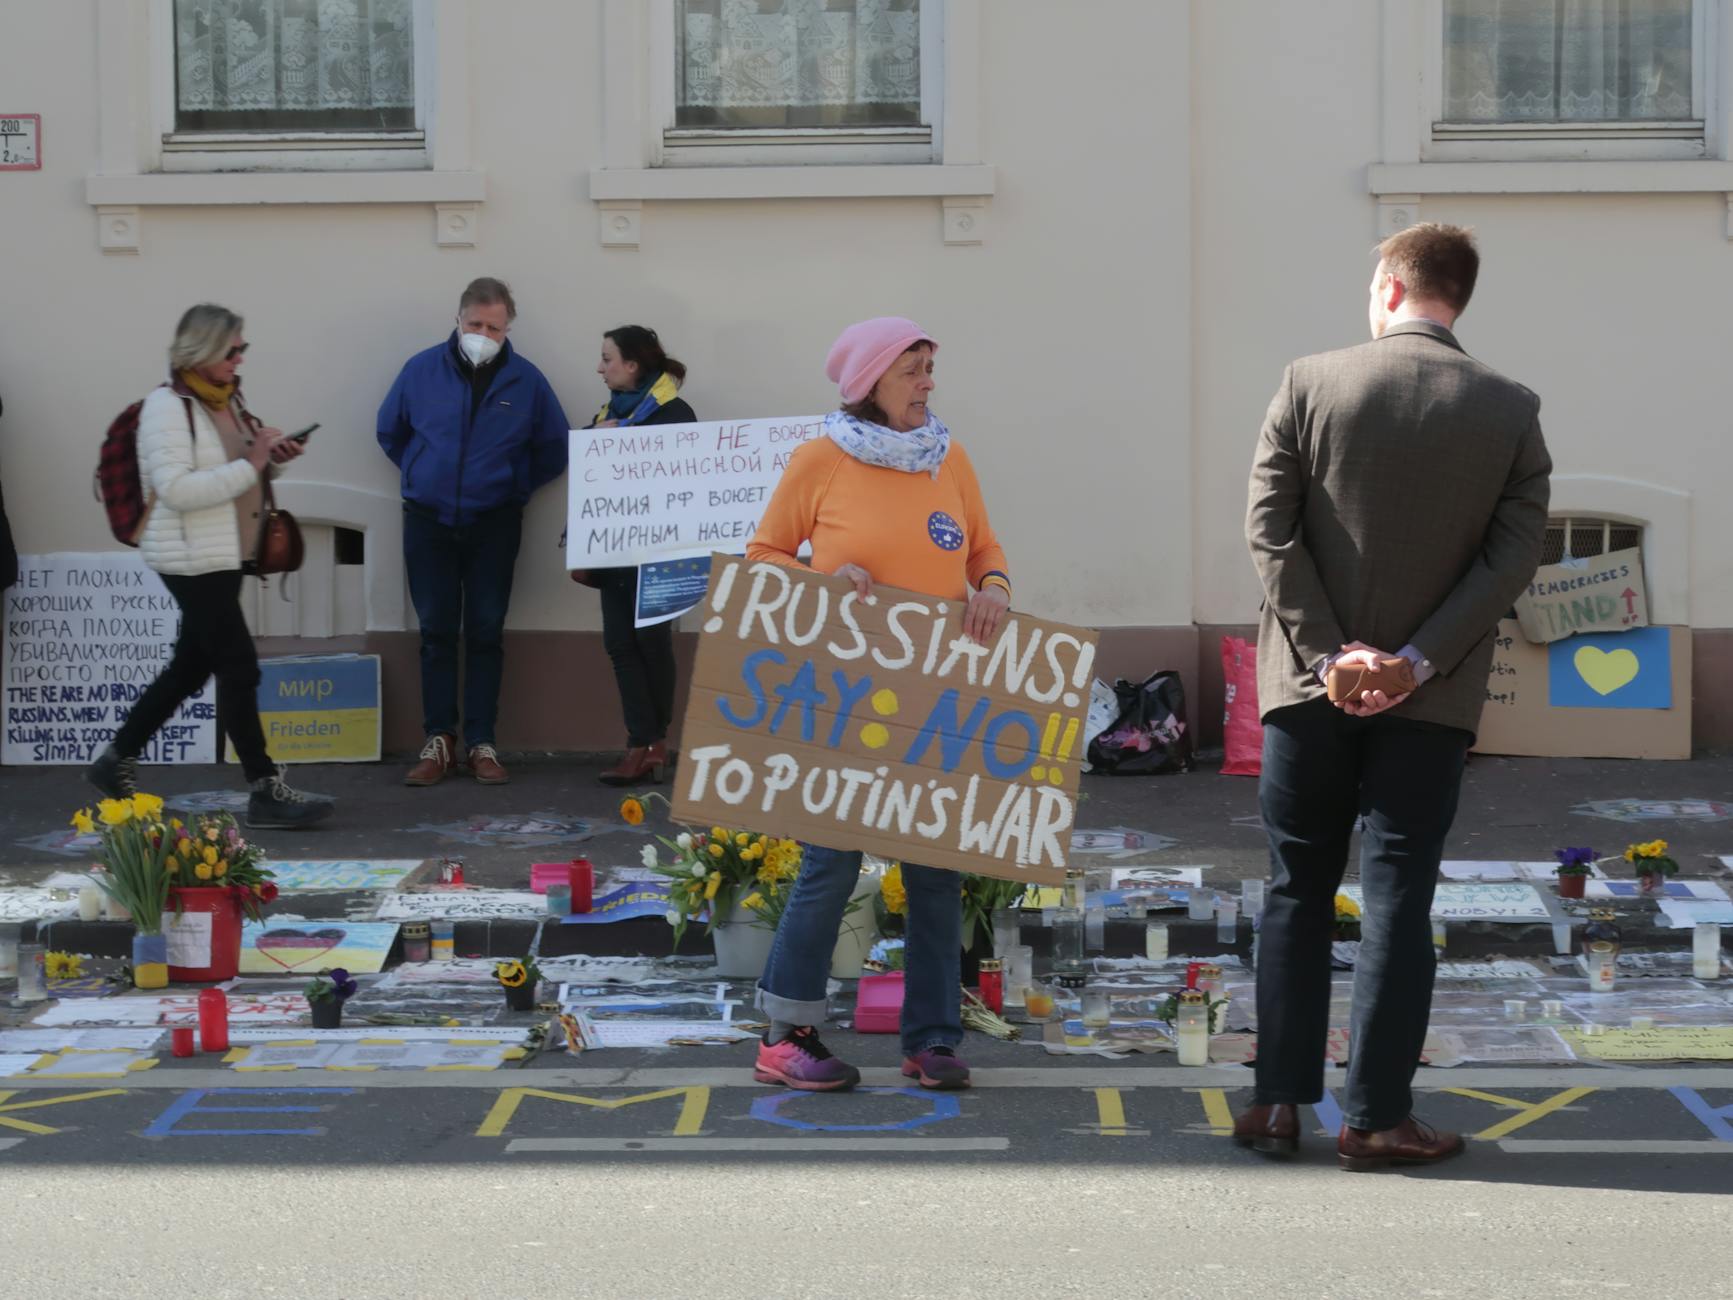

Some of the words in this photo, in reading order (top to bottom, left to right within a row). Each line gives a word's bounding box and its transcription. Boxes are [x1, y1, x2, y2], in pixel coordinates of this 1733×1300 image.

[585, 435, 664, 458] АРМИЯ
[676, 432, 699, 448] РФ
[717, 424, 752, 450] НЕ
[769, 422, 825, 443] ВОЮЕТ
[584, 468, 599, 483] С
[612, 448, 762, 481] УКРАИНСКОЙ
[581, 496, 650, 519] АРМИЯ
[667, 491, 693, 509] РФ
[709, 486, 767, 507] ВОЮЕТ
[587, 524, 679, 554] МИРНЫМ
[699, 521, 756, 542] НАСЕЛ
[67, 569, 144, 588] ПЛОХИХ
[10, 595, 93, 614] ХОРОШИХ
[1533, 594, 1616, 635] TAND
[9, 618, 72, 638] КОГДА
[83, 618, 164, 638] ПЛОХИЕ
[1495, 637, 1513, 650] op
[10, 665, 92, 683] ПРОСТО
[60, 685, 83, 702] ARE
[88, 685, 109, 702] NO
[279, 679, 333, 701] мир
[72, 706, 109, 724] WHEN
[181, 703, 216, 720] WERE
[716, 649, 899, 749] SAY:
[904, 688, 1080, 785] NO!!
[162, 726, 200, 740] KEPT
[270, 720, 341, 737] Frieden
[689, 745, 753, 804] TO
[958, 773, 1072, 868] WAR
